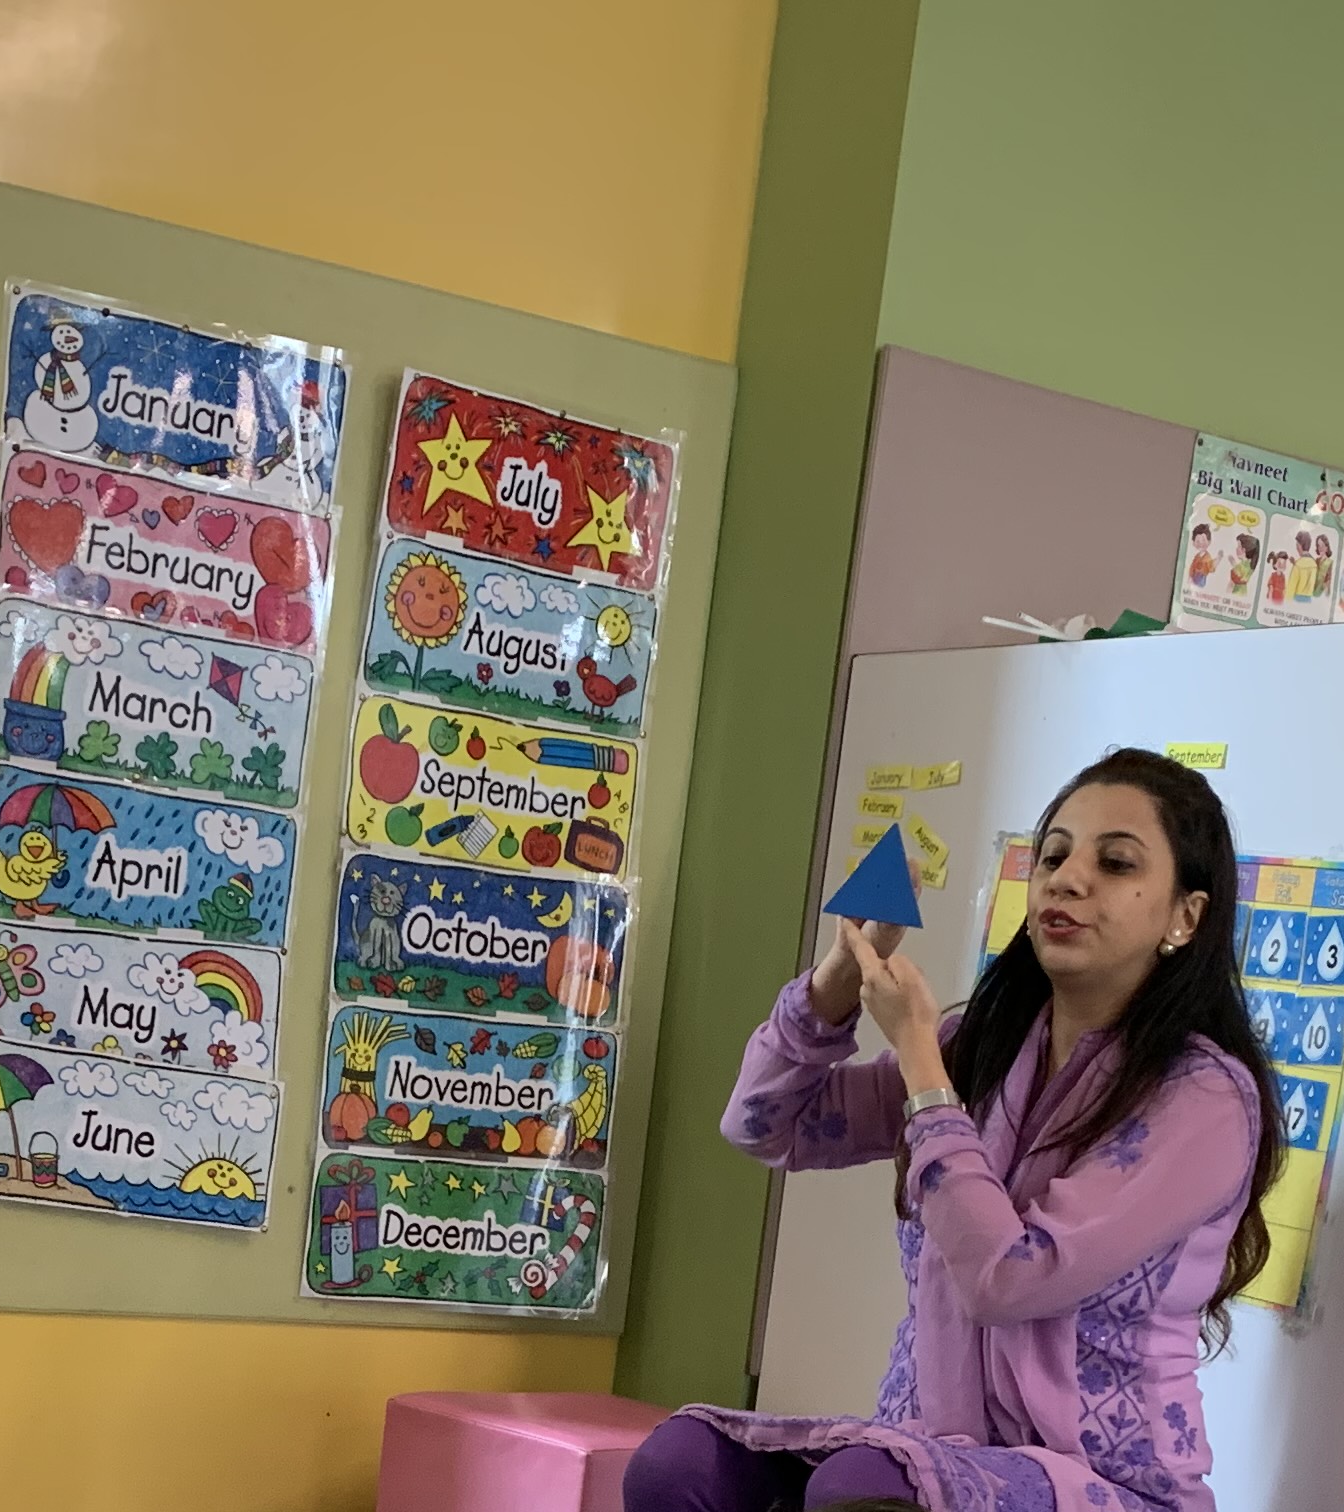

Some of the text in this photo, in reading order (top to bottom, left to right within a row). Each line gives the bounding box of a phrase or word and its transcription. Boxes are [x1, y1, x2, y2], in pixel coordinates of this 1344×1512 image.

[102, 372, 257, 456] January
[500, 463, 560, 524] July
[1197, 470, 1309, 514] Big Wall Chart
[85, 524, 256, 611] February
[88, 671, 213, 734] March
[420, 758, 586, 818] September
[863, 798, 897, 817] February
[91, 839, 183, 898] April
[577, 843, 614, 861] LUNCH
[406, 912, 547, 964] October
[1269, 939, 1338, 969] 2 3
[77, 985, 157, 1044] May
[1308, 1026, 1326, 1049] 10
[389, 1059, 555, 1111] November
[72, 1109, 156, 1158] June
[1285, 1106, 1304, 1130] 17
[382, 1210, 546, 1256] December
